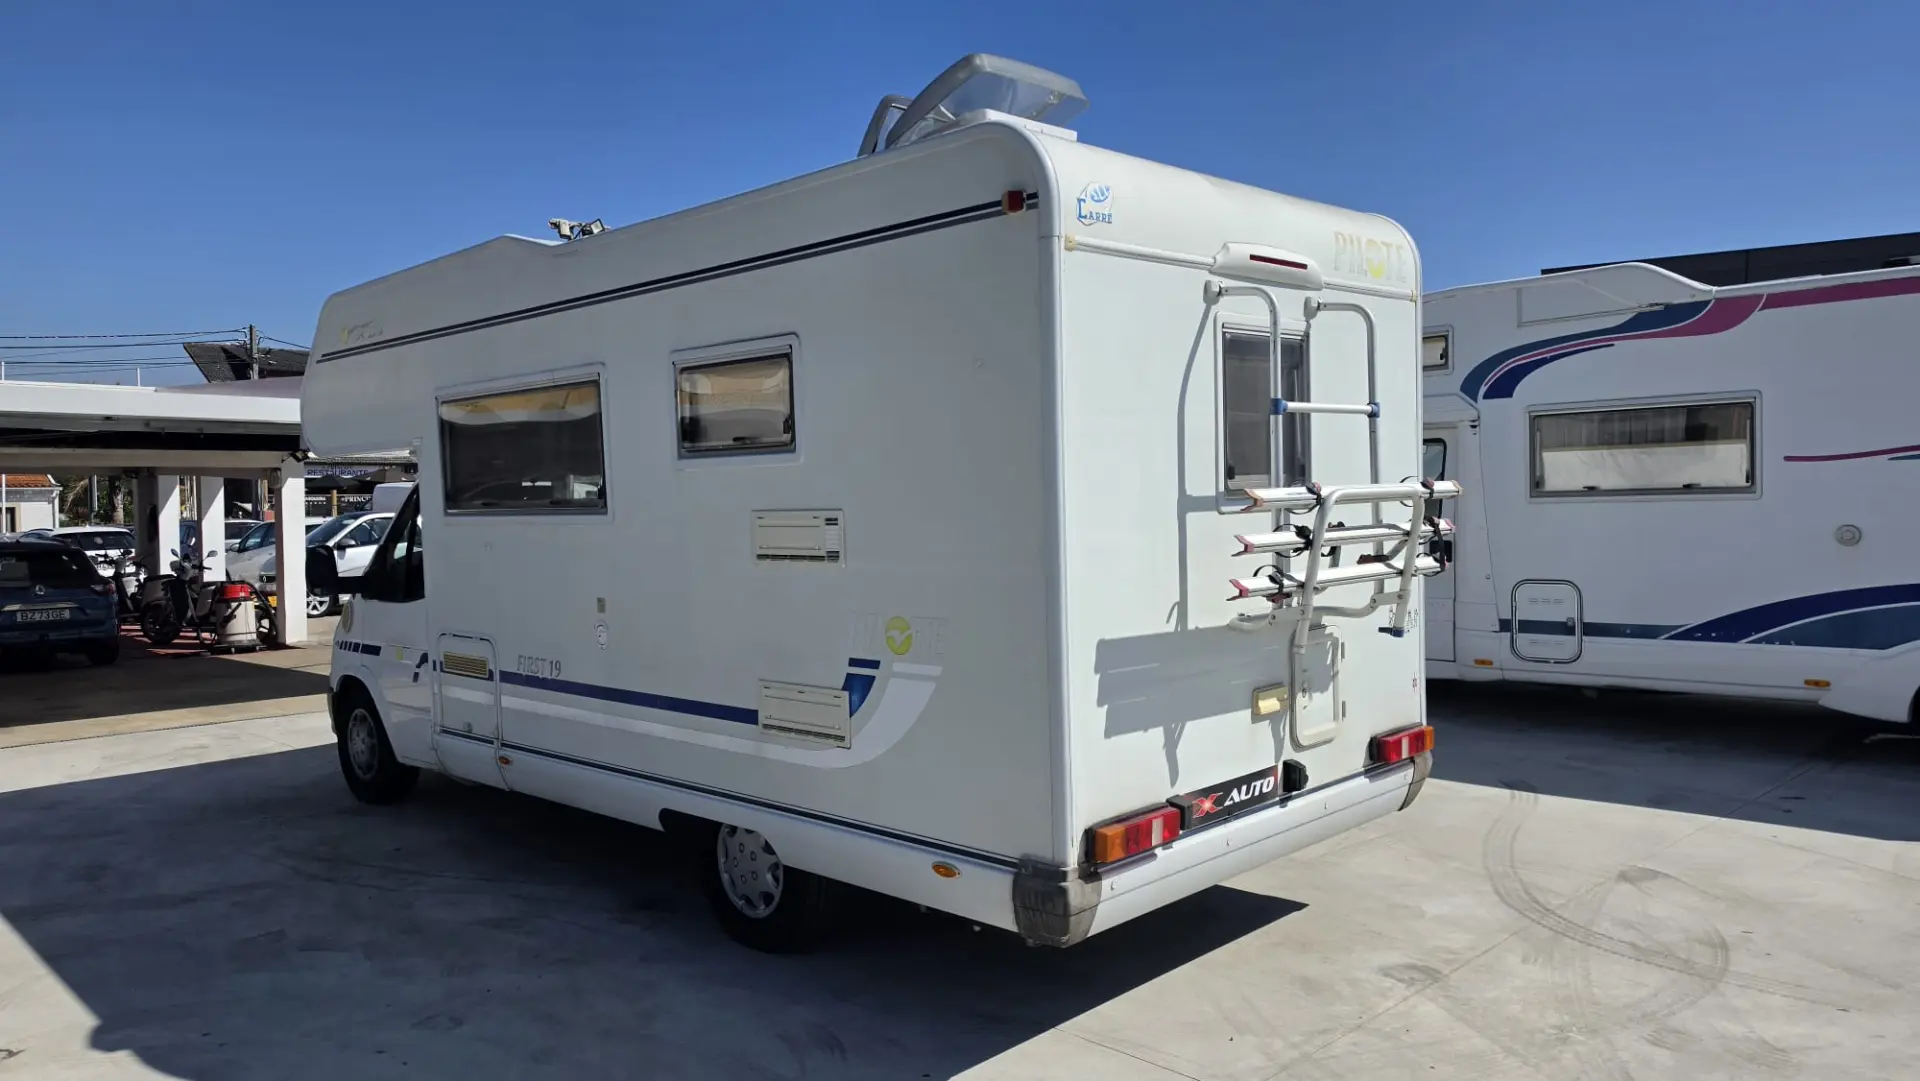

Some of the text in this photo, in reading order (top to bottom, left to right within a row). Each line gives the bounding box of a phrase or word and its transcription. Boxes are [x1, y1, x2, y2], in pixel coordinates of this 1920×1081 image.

[517, 654, 562, 678] FIRST 19
[1224, 776, 1275, 807] AUTO
